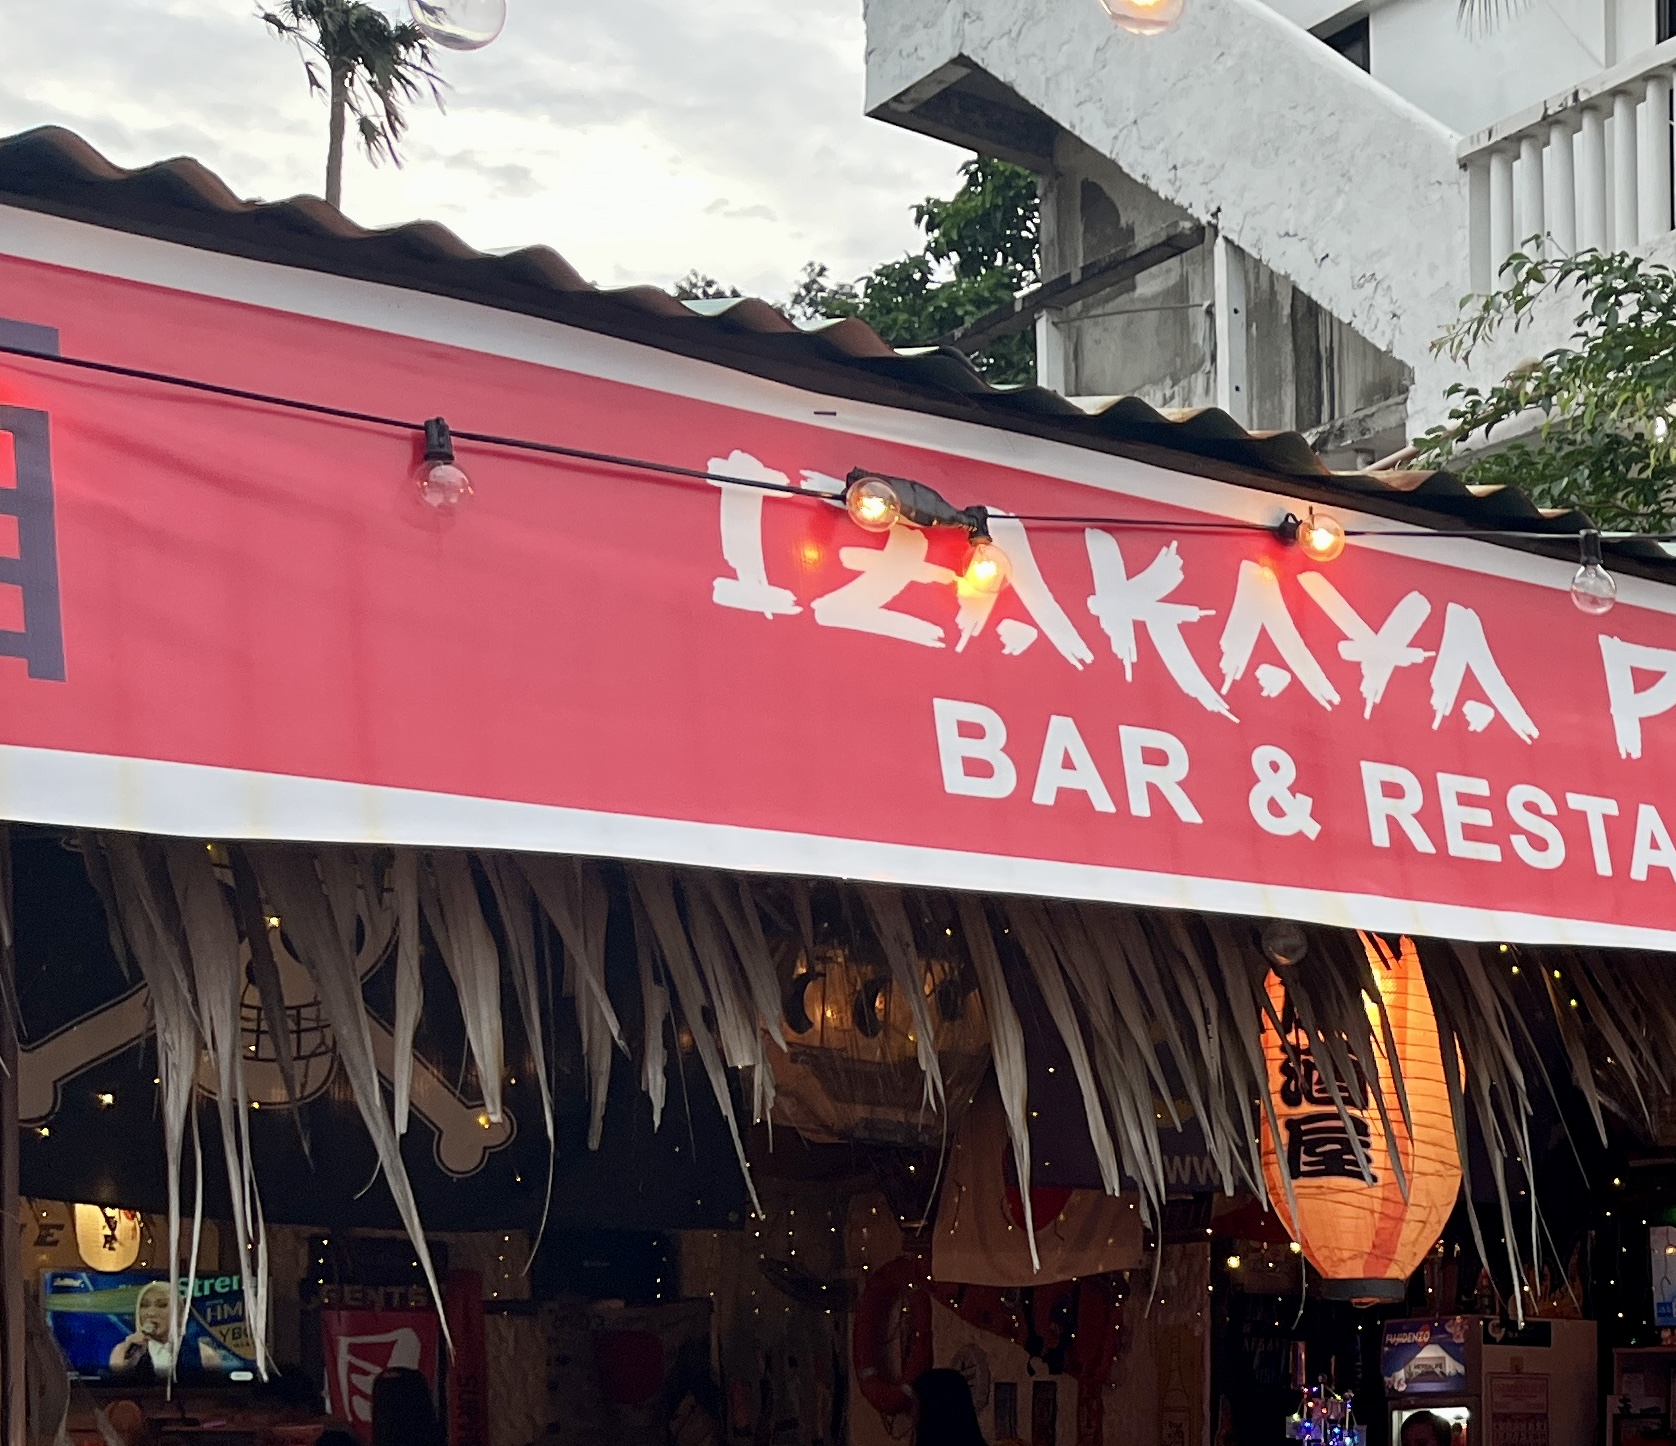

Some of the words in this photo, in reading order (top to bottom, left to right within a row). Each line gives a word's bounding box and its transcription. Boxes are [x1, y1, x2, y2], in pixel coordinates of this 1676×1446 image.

[706, 450, 1540, 744] IZAKAYA
[932, 697, 1204, 824] BAR
[1248, 744, 1322, 841] &
